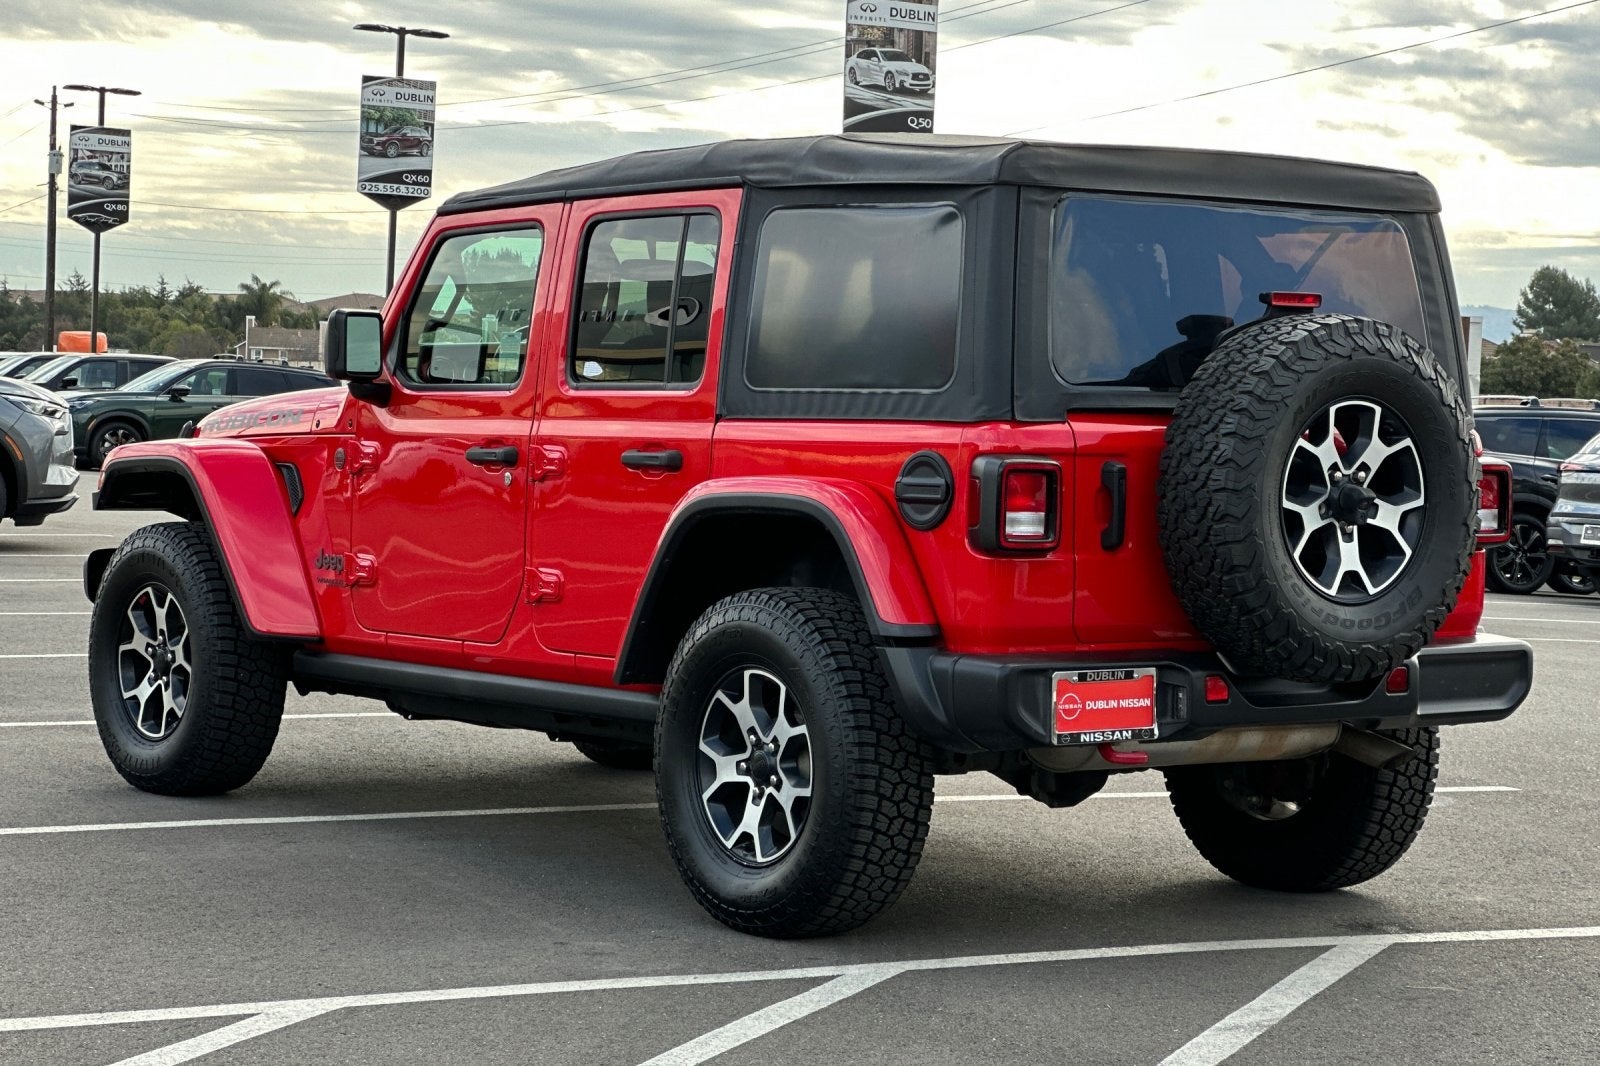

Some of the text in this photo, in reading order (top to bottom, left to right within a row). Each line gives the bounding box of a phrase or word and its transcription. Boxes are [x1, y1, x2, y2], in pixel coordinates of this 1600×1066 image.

[889, 7, 936, 22] DUBLIN
[395, 91, 434, 103] DUBLIN
[907, 116, 932, 129] Q50
[97, 137, 130, 147] DUBLIN
[402, 173, 430, 183] QX60
[360, 183, 430, 196] 925.556.3200
[103, 203, 127, 211] QX80
[201, 408, 305, 433] RUBICON
[315, 548, 344, 575] Jeep
[1086, 671, 1126, 681] DUBLIN
[1085, 698, 1151, 710] DUBLIN NISSAN
[1080, 730, 1132, 743] NISSAN
